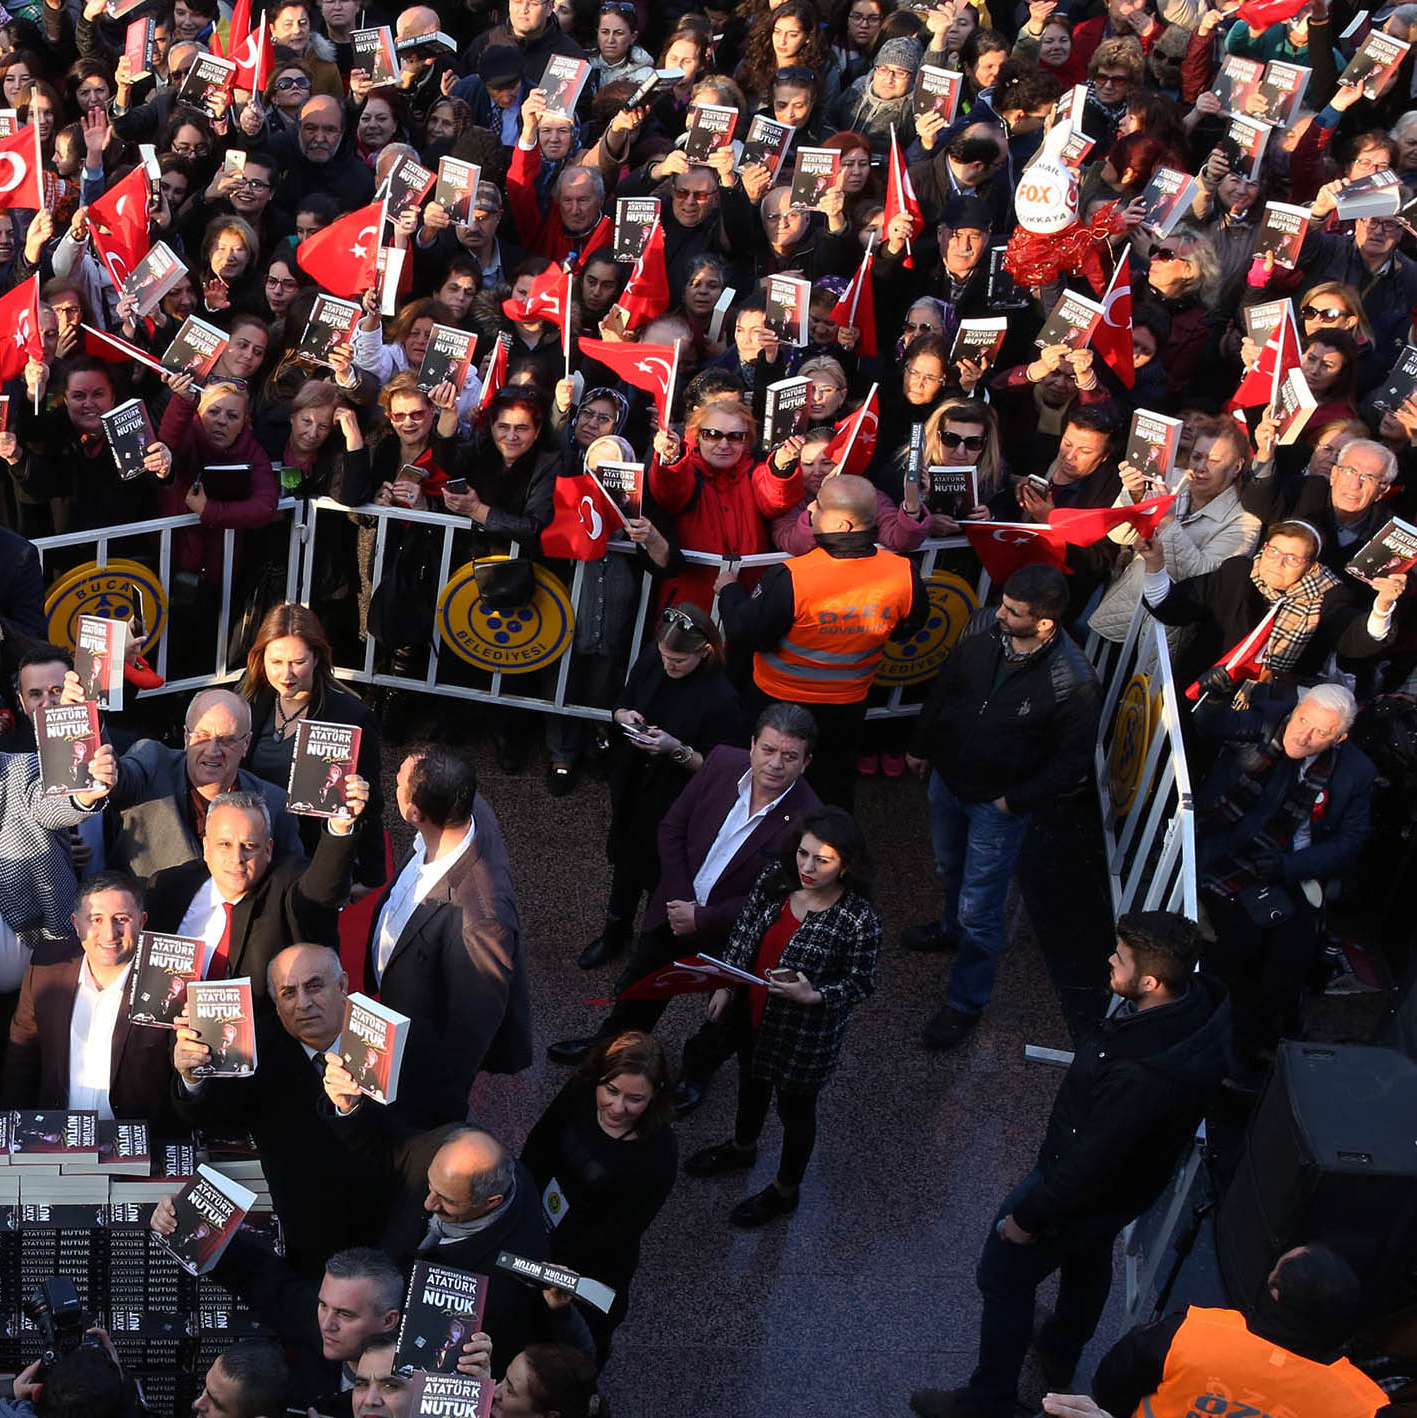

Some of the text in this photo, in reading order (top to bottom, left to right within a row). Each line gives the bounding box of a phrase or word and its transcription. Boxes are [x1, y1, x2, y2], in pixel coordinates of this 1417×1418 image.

[352, 33, 380, 42] ATATÜRK
[354, 41, 381, 53] NUTUK
[1019, 184, 1052, 204] FOX
[627, 203, 655, 213] ATATÜRK
[625, 211, 655, 223] NUTUK
[319, 310, 350, 328] NUTUK
[322, 302, 353, 319] ATATÜRK
[437, 331, 468, 346] ATATÜRK
[434, 341, 467, 358] NUTUK
[779, 387, 807, 400] ATATÜRK
[778, 396, 807, 411] NUTUK
[114, 408, 141, 426] ATATÜRK
[117, 417, 144, 436] NUTUK
[603, 470, 635, 479] ATATÜRK
[934, 475, 966, 483] ATATÜRK
[602, 478, 635, 490] NUTUK
[934, 484, 967, 492] NUTUK
[1390, 531, 1417, 549] ATATÜR
[76, 580, 130, 600] BUCA
[456, 630, 547, 661] BELEDİYESİ
[45, 710, 89, 721] ATATÜRK
[46, 723, 91, 738] NUTUK
[309, 730, 352, 743] ATATÜRK
[307, 743, 350, 759] NUTUK
[151, 942, 195, 955] ATATÜRK
[149, 955, 193, 970] NUTUK
[197, 991, 241, 1003] ATATÜRK
[197, 1003, 241, 1018] NUTUK
[67, 1115, 78, 1147] NUTUK
[82, 1115, 91, 1147] ATATÜRK
[118, 1124, 130, 1157] NUTUK
[133, 1124, 142, 1156] ATATÜRK
[165, 1145, 177, 1177] NUTUK
[181, 1145, 190, 1176] ATATÜRK
[196, 1183, 233, 1216] ATATÜRK
[187, 1191, 227, 1228] NUTUK
[513, 1257, 578, 1286] ATATÜRK NUTUK
[427, 1273, 477, 1294] ATATÜRK
[422, 1290, 475, 1314] NUTUK
[423, 1382, 480, 1398] ATATÜRK
[420, 1400, 479, 1418] NUTUK
